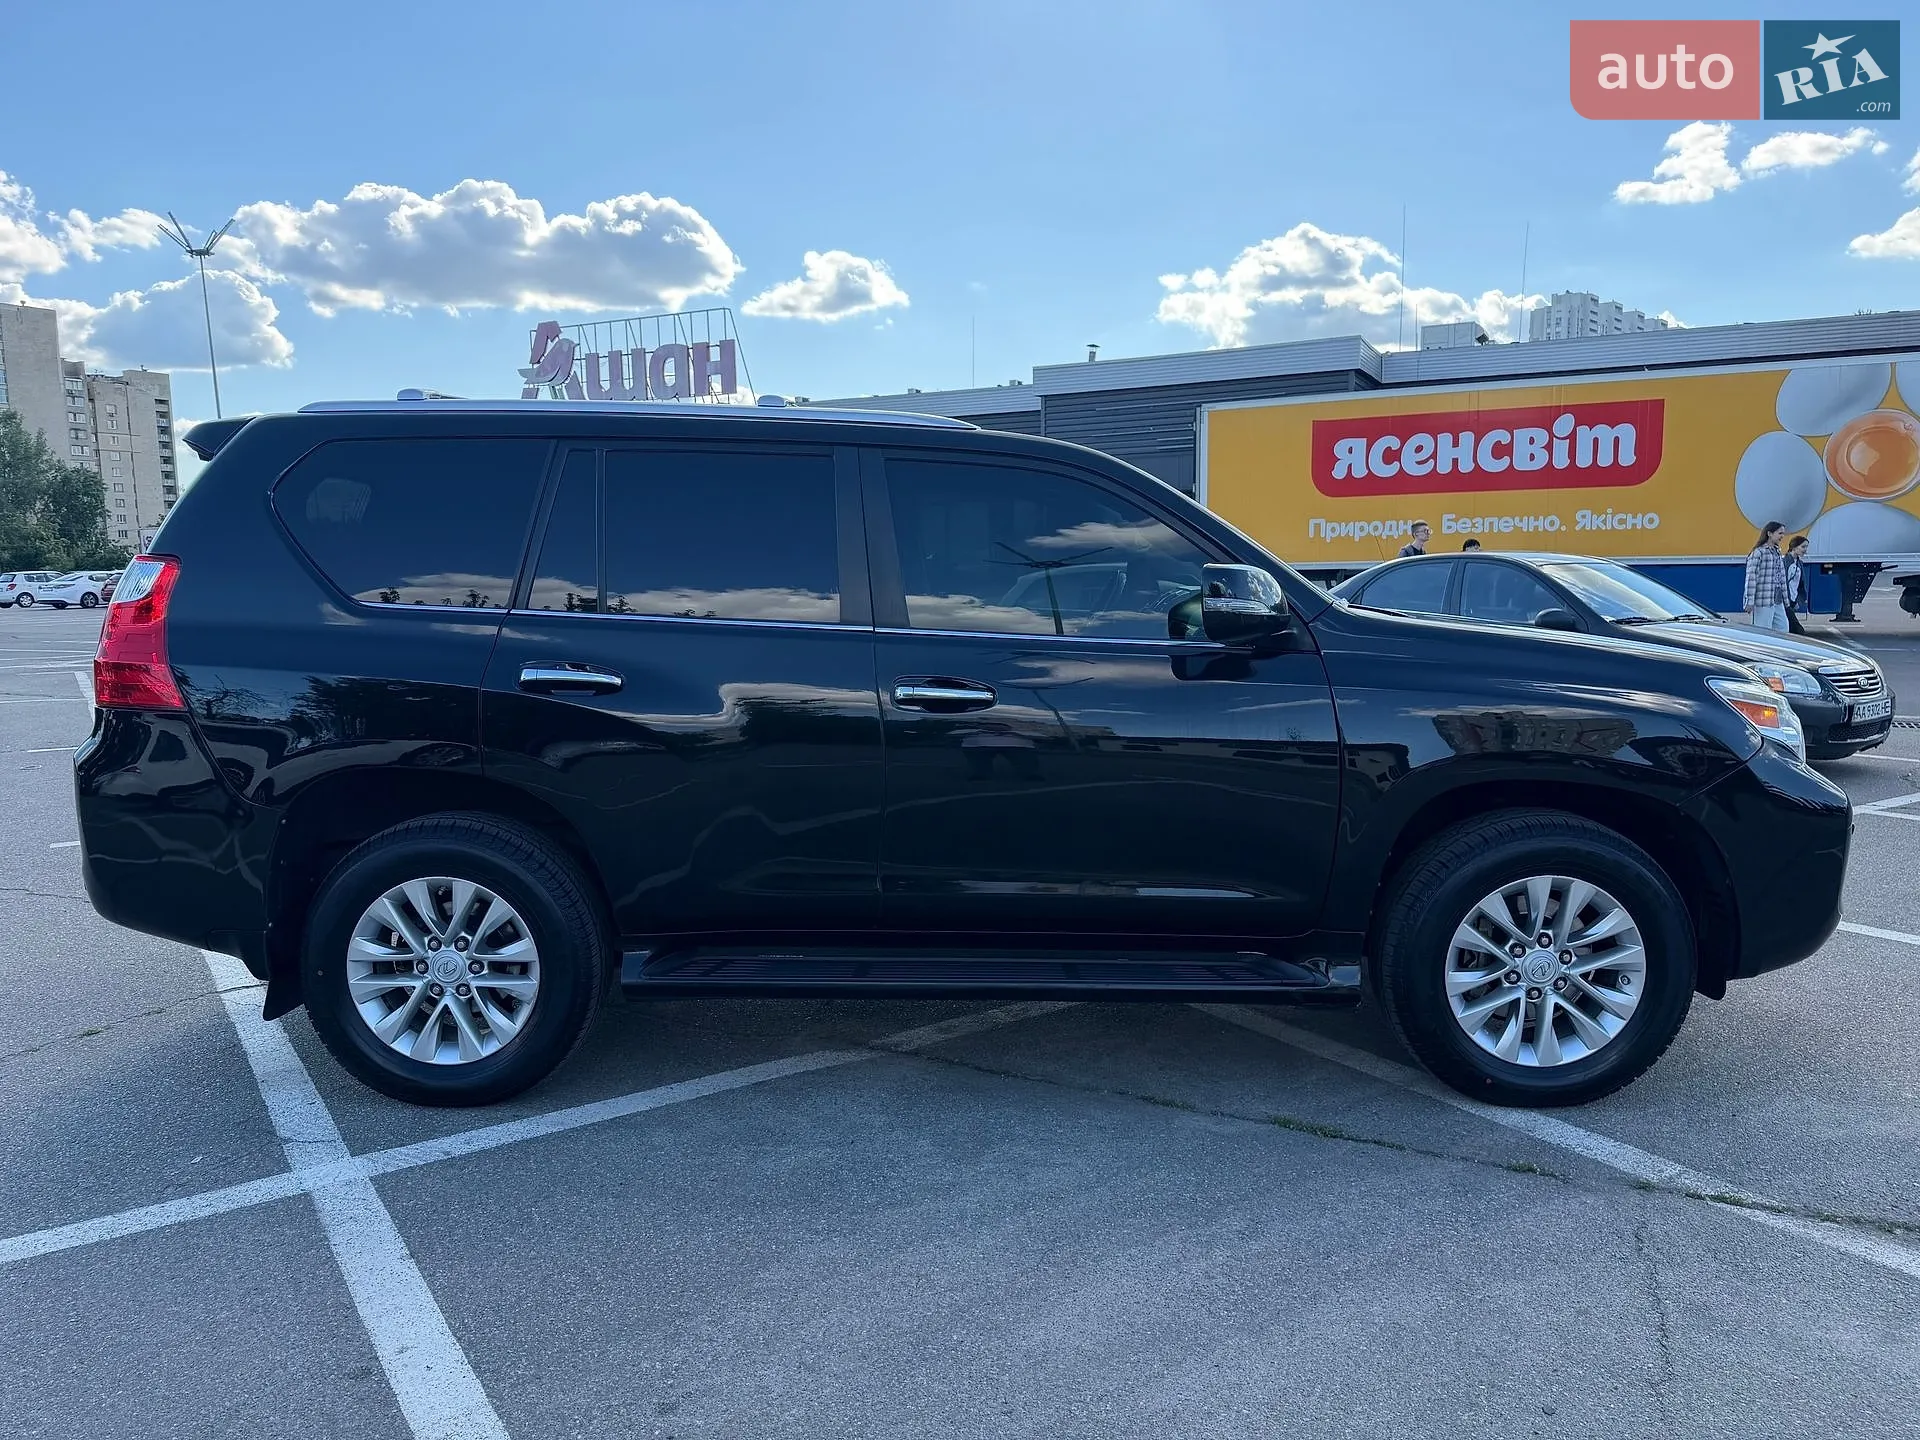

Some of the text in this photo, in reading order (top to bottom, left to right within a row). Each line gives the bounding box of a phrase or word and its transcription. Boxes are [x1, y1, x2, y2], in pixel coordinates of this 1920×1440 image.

[1308, 508, 1660, 543] Природн Безпечно. Якісно
